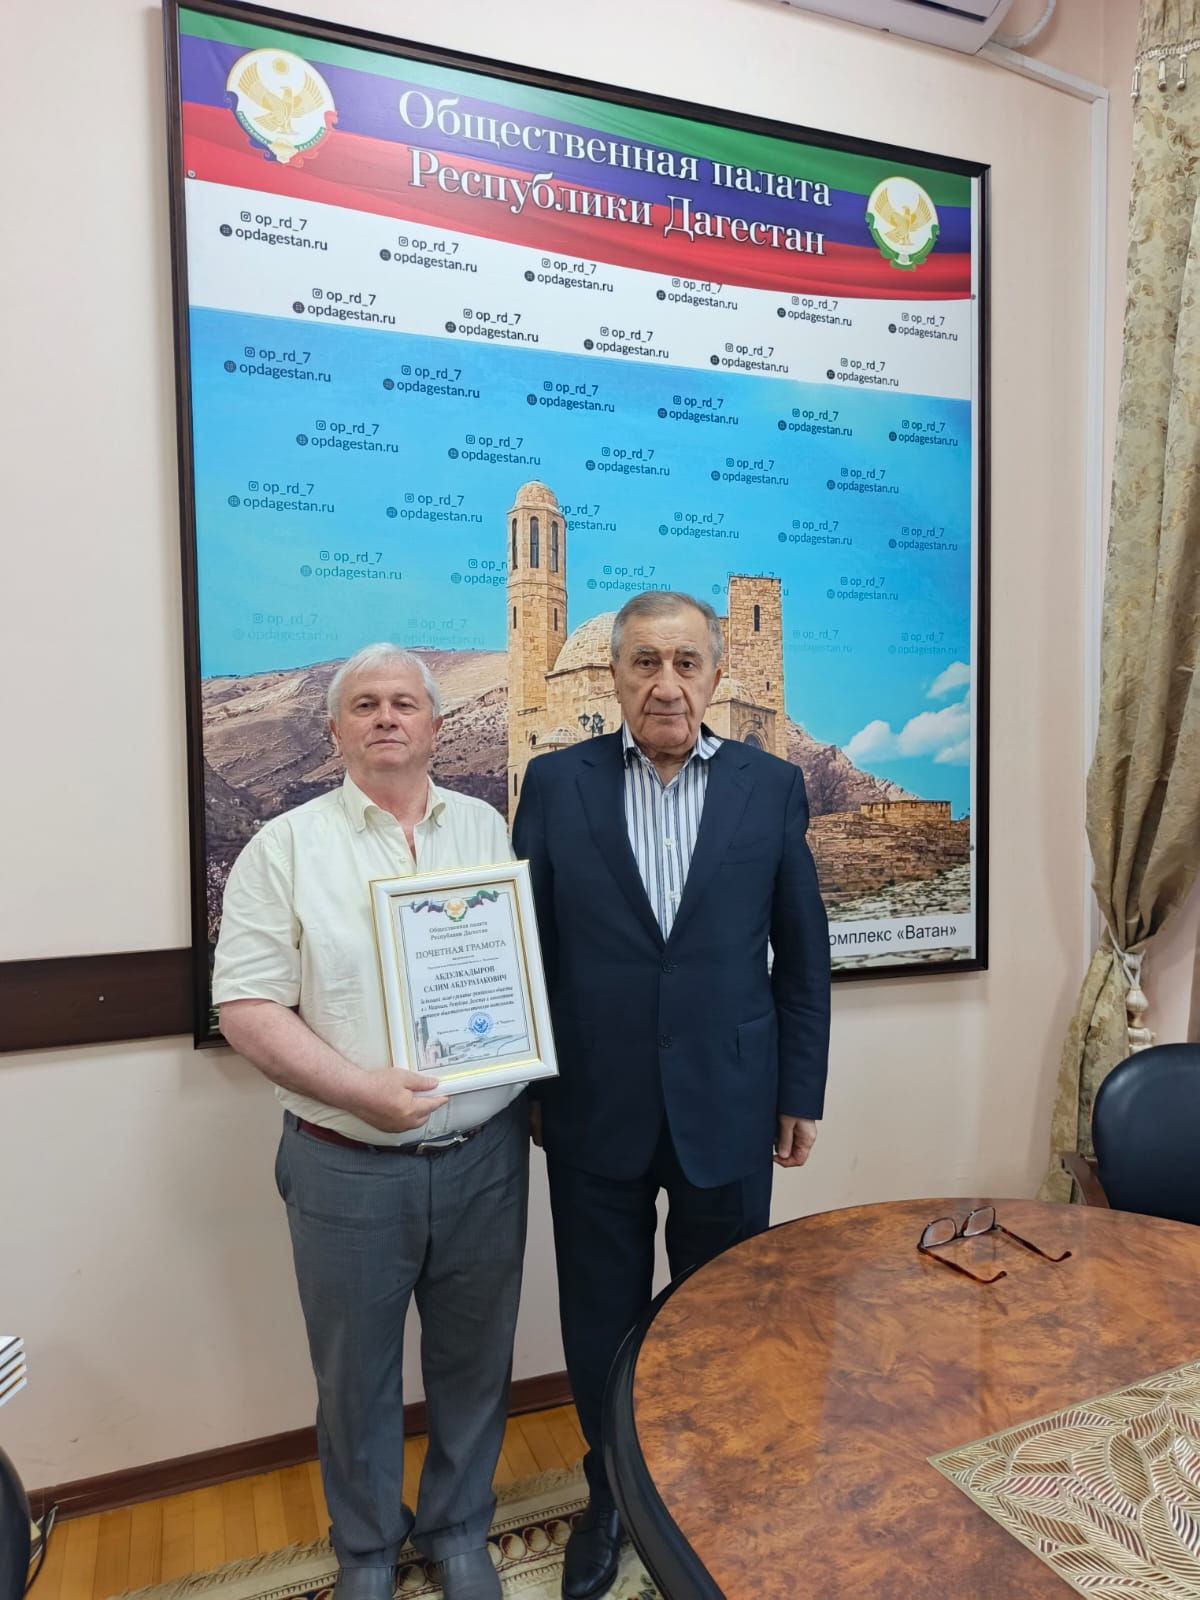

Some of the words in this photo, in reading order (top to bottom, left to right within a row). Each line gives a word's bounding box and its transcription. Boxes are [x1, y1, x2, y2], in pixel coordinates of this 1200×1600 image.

[399, 88, 700, 183] Общественная
[712, 160, 832, 207] палата
[407, 147, 653, 226] Республики
[664, 195, 826, 257] Дагестан
[255, 212, 307, 231] op_rd_7
[235, 225, 327, 251] opdagestan.ru
[412, 237, 459, 254] op_rd_7
[394, 251, 477, 273] opdagestan.ru
[553, 257, 597, 275] op_rd_7
[537, 272, 614, 293] opdagestan.ru
[683, 279, 722, 293] op_rd_7
[326, 289, 376, 306] op_rd_7
[668, 290, 738, 311] opdagestan.ru
[802, 297, 838, 311] op_rd_7
[308, 302, 396, 325] opdagestan.ru
[476, 309, 521, 325] op_rd_7
[788, 308, 852, 327] opdagestan.ru
[911, 313, 944, 327] op_rd_7
[459, 323, 538, 343] opdagestan.ru
[612, 328, 653, 342] op_rd_7
[898, 324, 958, 342] opdagestan.ru
[259, 348, 311, 364] op_rd_7
[596, 340, 669, 359] opdagestan.ru
[736, 344, 773, 358] op_rd_7
[240, 361, 331, 383] opdagestan.ru
[722, 355, 789, 374] opdagestan.ru
[850, 359, 885, 372] op_rd_7
[415, 366, 461, 382] op_rd_7
[837, 370, 899, 387] opdagestan.ru
[397, 379, 480, 399] opdagestan.ru
[555, 381, 599, 397] op_rd_7
[539, 394, 615, 414] opdagestan.ru
[684, 396, 723, 409] op_rd_7
[669, 409, 738, 426] opdagestan.ru
[802, 409, 838, 422] op_rd_7
[330, 421, 379, 436] op_rd_7
[789, 421, 853, 437] opdagestan.ru
[911, 420, 945, 432] op_rd_7
[311, 434, 399, 454] opdagestan.ru
[479, 435, 523, 450] op_rd_7
[899, 432, 958, 447] opdagestan.ru
[461, 448, 541, 466] opdagestan.ru
[613, 448, 654, 461] op_rd_7
[598, 461, 670, 477] opdagestan.ru
[736, 459, 774, 472] op_rd_7
[722, 472, 789, 486] opdagestan.ru
[850, 468, 885, 480] op_rd_7
[263, 481, 314, 496] op_rd_7
[837, 480, 899, 495] opdagestan.ru
[243, 496, 335, 514] opdagestan.ru
[418, 494, 464, 508] op_rd_7
[400, 508, 482, 523] opdagestan.ru
[685, 512, 724, 526] op_rd_7
[567, 520, 617, 531] gestan.ru
[670, 526, 739, 538] opdagestan.ru
[802, 520, 839, 533] op_rd_7
[911, 527, 944, 539] op_rd_7
[789, 533, 852, 545] opdagestan.ru
[898, 540, 958, 551] opdagestan.ru
[334, 551, 382, 565] op_rd_7
[315, 565, 402, 581] opdagestan.ru
[615, 565, 655, 578] op_rd_7
[850, 576, 885, 588] op_rd_7
[837, 589, 898, 600] opdagestan.ru
[828, 930, 892, 946] омплекс
[897, 924, 957, 940] «Ватан»
[415, 945, 464, 960] ПОЧЕТНАЯ
[466, 939, 507, 953] ГРАМОТА
